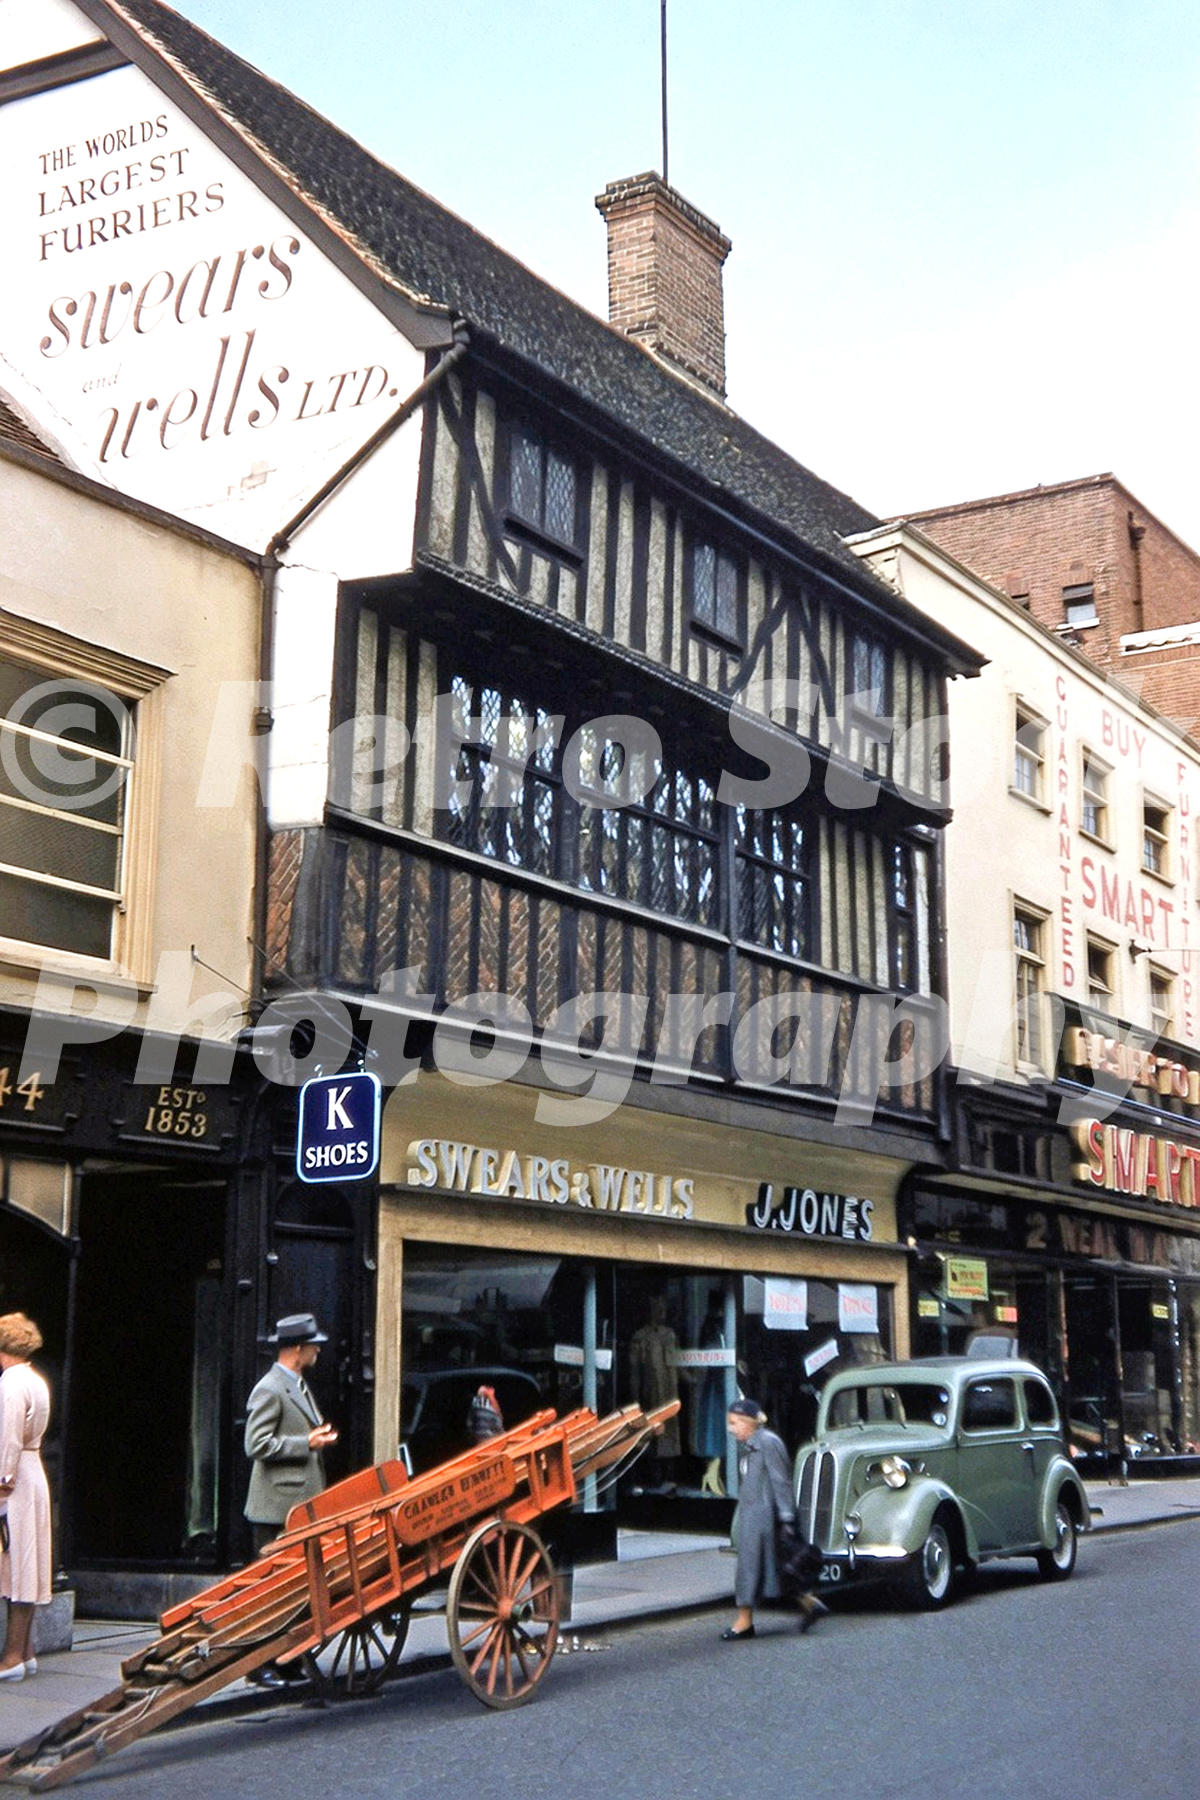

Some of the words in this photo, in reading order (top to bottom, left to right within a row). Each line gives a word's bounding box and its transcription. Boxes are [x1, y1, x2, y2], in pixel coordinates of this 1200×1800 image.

[39, 144, 76, 175] THE
[86, 114, 168, 158] WORLDS
[38, 148, 189, 217] LARGEST
[39, 182, 225, 261] FURRIERS
[292, 364, 398, 421] LTD.
[1102, 709, 1146, 768] BUY
[1081, 857, 1174, 948] SMART
[145, 1107, 207, 1138] 1853
[326, 1086, 354, 1130] K
[305, 1141, 368, 1169] SHOES
